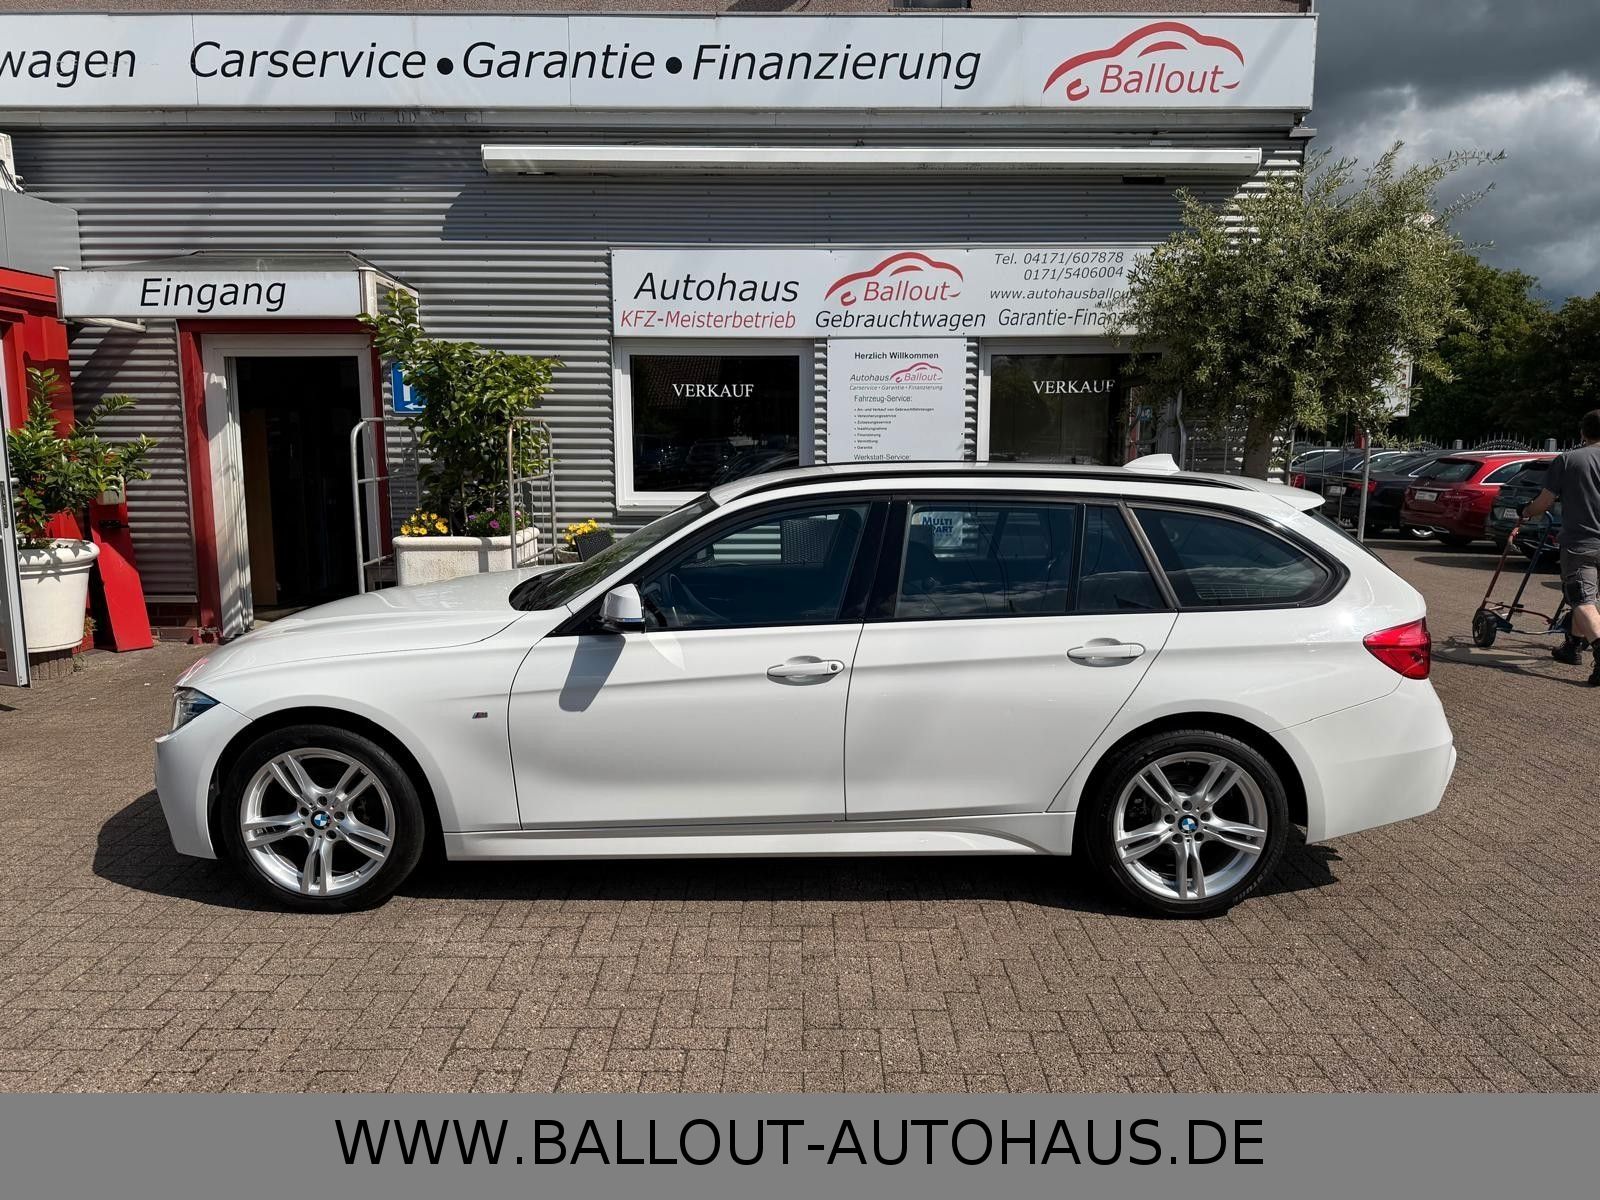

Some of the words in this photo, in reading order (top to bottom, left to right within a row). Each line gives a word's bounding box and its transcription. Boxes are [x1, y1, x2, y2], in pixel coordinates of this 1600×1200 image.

[0, 50, 136, 88] wagen
[190, 41, 427, 80] Carservice
[462, 41, 655, 80] Garantie
[692, 43, 982, 91] Finanzierung
[1099, 63, 1224, 94] Ballout
[995, 253, 1018, 265] Tel.
[1023, 252, 1124, 266] 04171/607878
[1023, 266, 1124, 281] 0171/5406004
[140, 277, 287, 313] Eingang
[634, 272, 800, 303] Autohaus
[862, 280, 951, 302] Ballout
[620, 310, 796, 329] KFZ-Meisterbetrieb
[814, 308, 987, 331] Gebrauchtwagen
[854, 352, 888, 360] Herzlich
[889, 352, 939, 360] Willkommen
[850, 374, 889, 382] Autohaus
[904, 373, 937, 381] Ballout
[672, 383, 755, 398] VERKAUF
[1032, 380, 1115, 394] VERKAUF
[854, 395, 913, 403] Fahrzeug-Service:
[922, 517, 953, 526] MULTI
